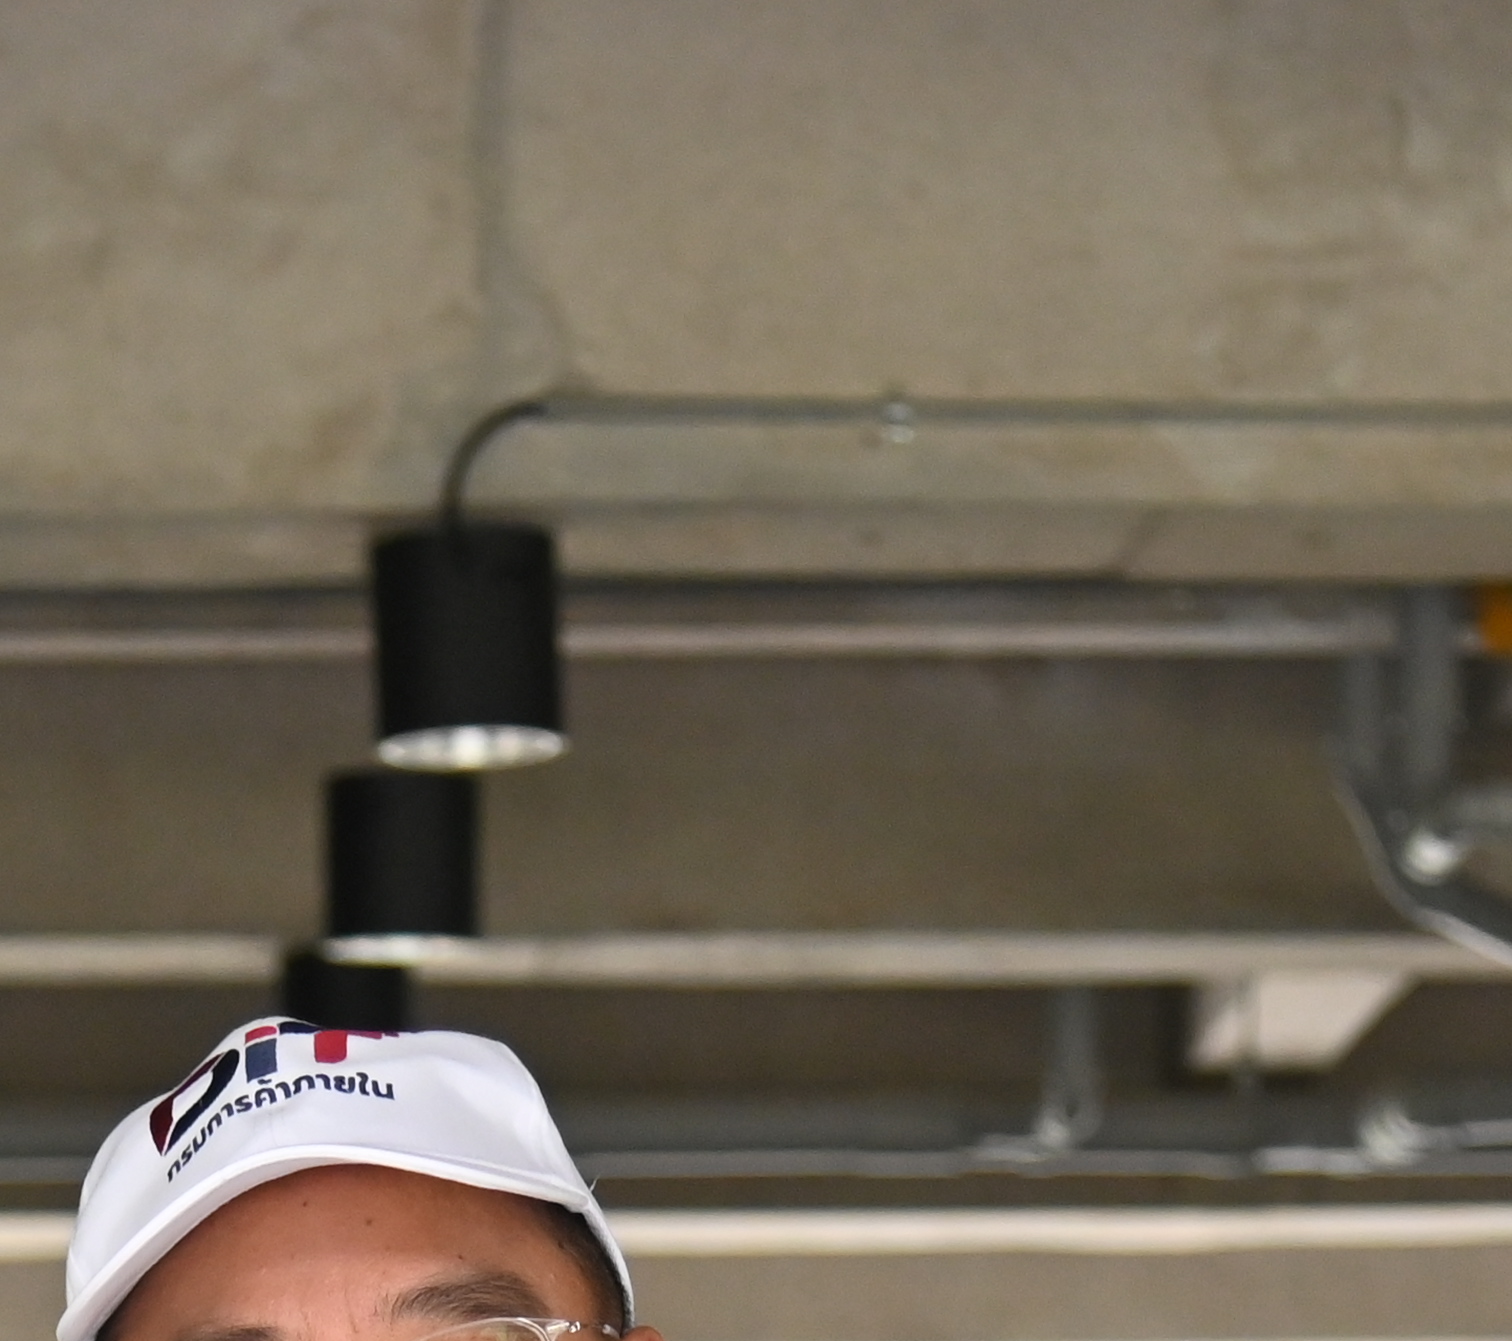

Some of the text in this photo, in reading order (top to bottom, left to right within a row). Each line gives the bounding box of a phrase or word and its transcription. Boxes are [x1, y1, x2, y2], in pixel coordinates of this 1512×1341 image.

[166, 1071, 396, 1183] กรมการค้าภายใน
